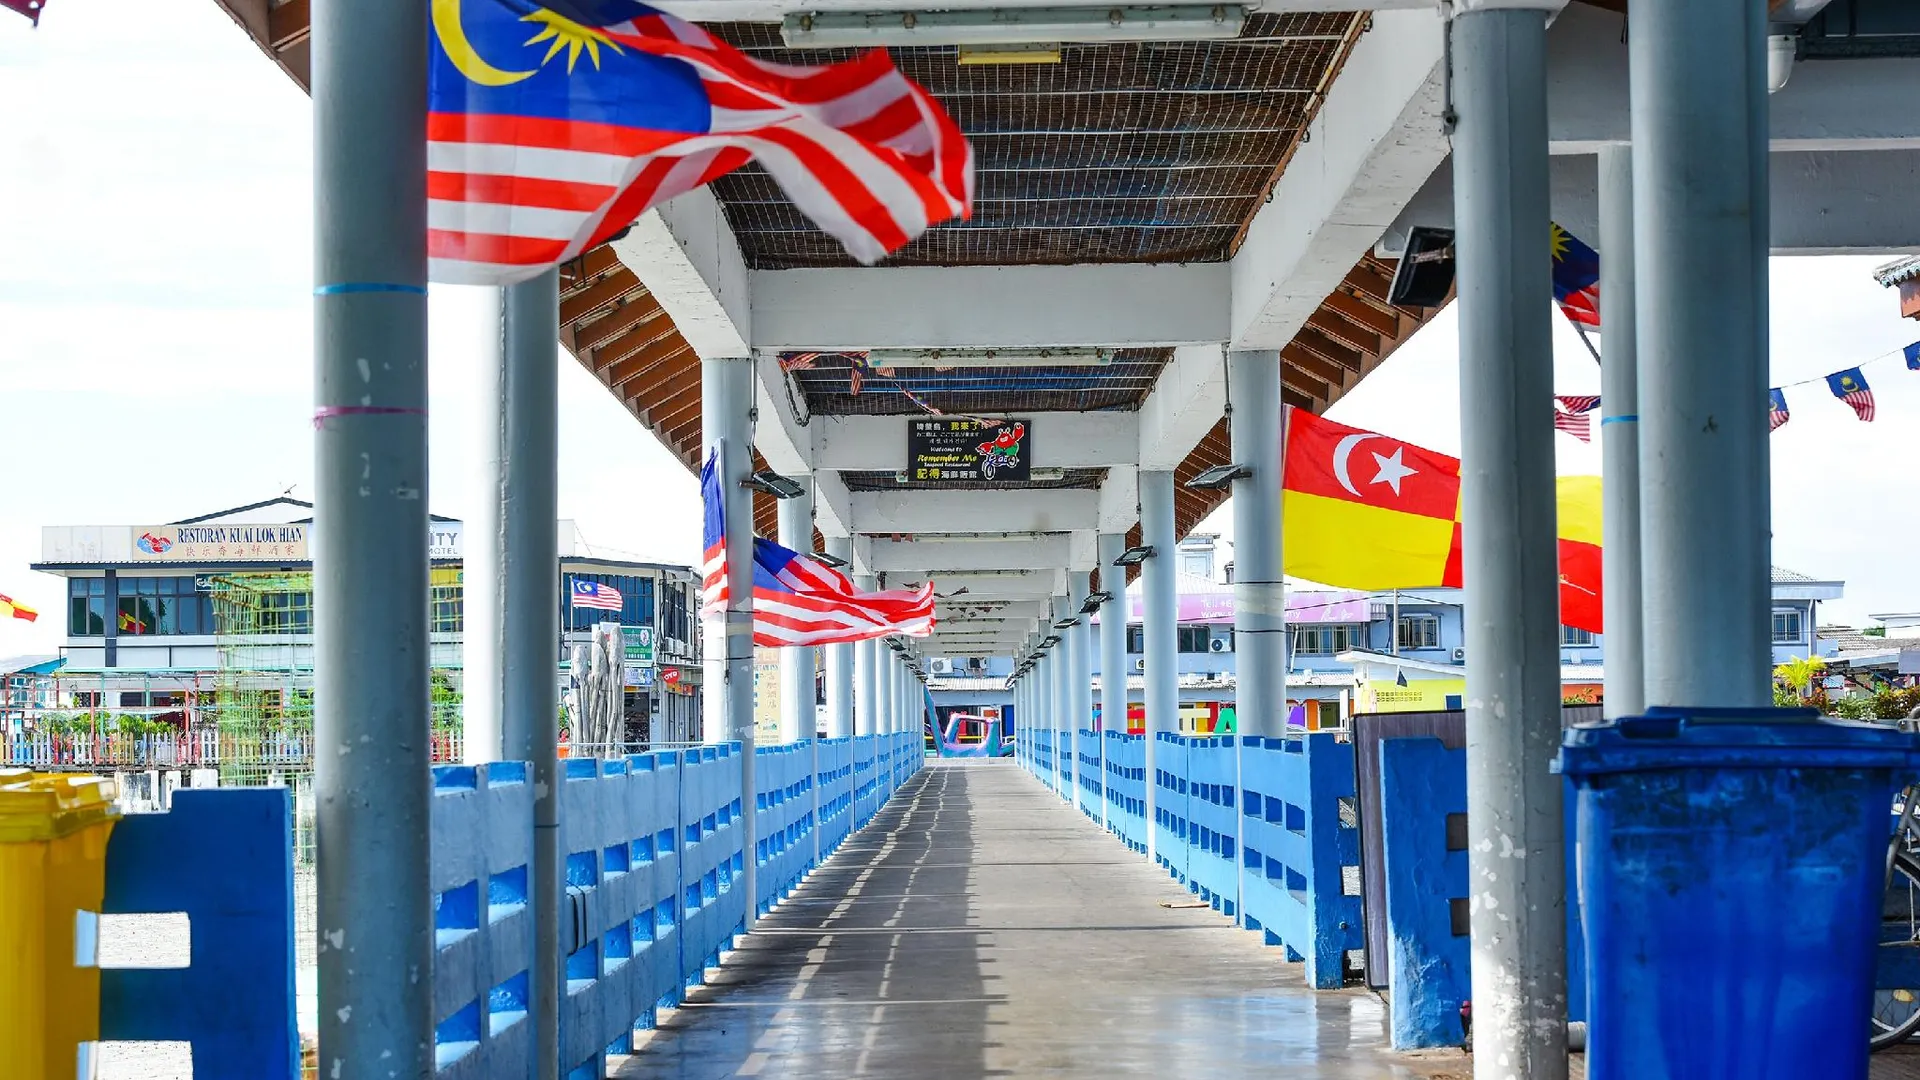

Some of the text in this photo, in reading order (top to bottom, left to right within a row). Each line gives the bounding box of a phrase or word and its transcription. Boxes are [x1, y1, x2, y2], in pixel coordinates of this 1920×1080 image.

[917, 453, 977, 462] Remember Me
[177, 527, 303, 543] RESTORAN KUAI LOK HIAN
[429, 533, 458, 546] ITY
[663, 671, 678, 680] OYO
